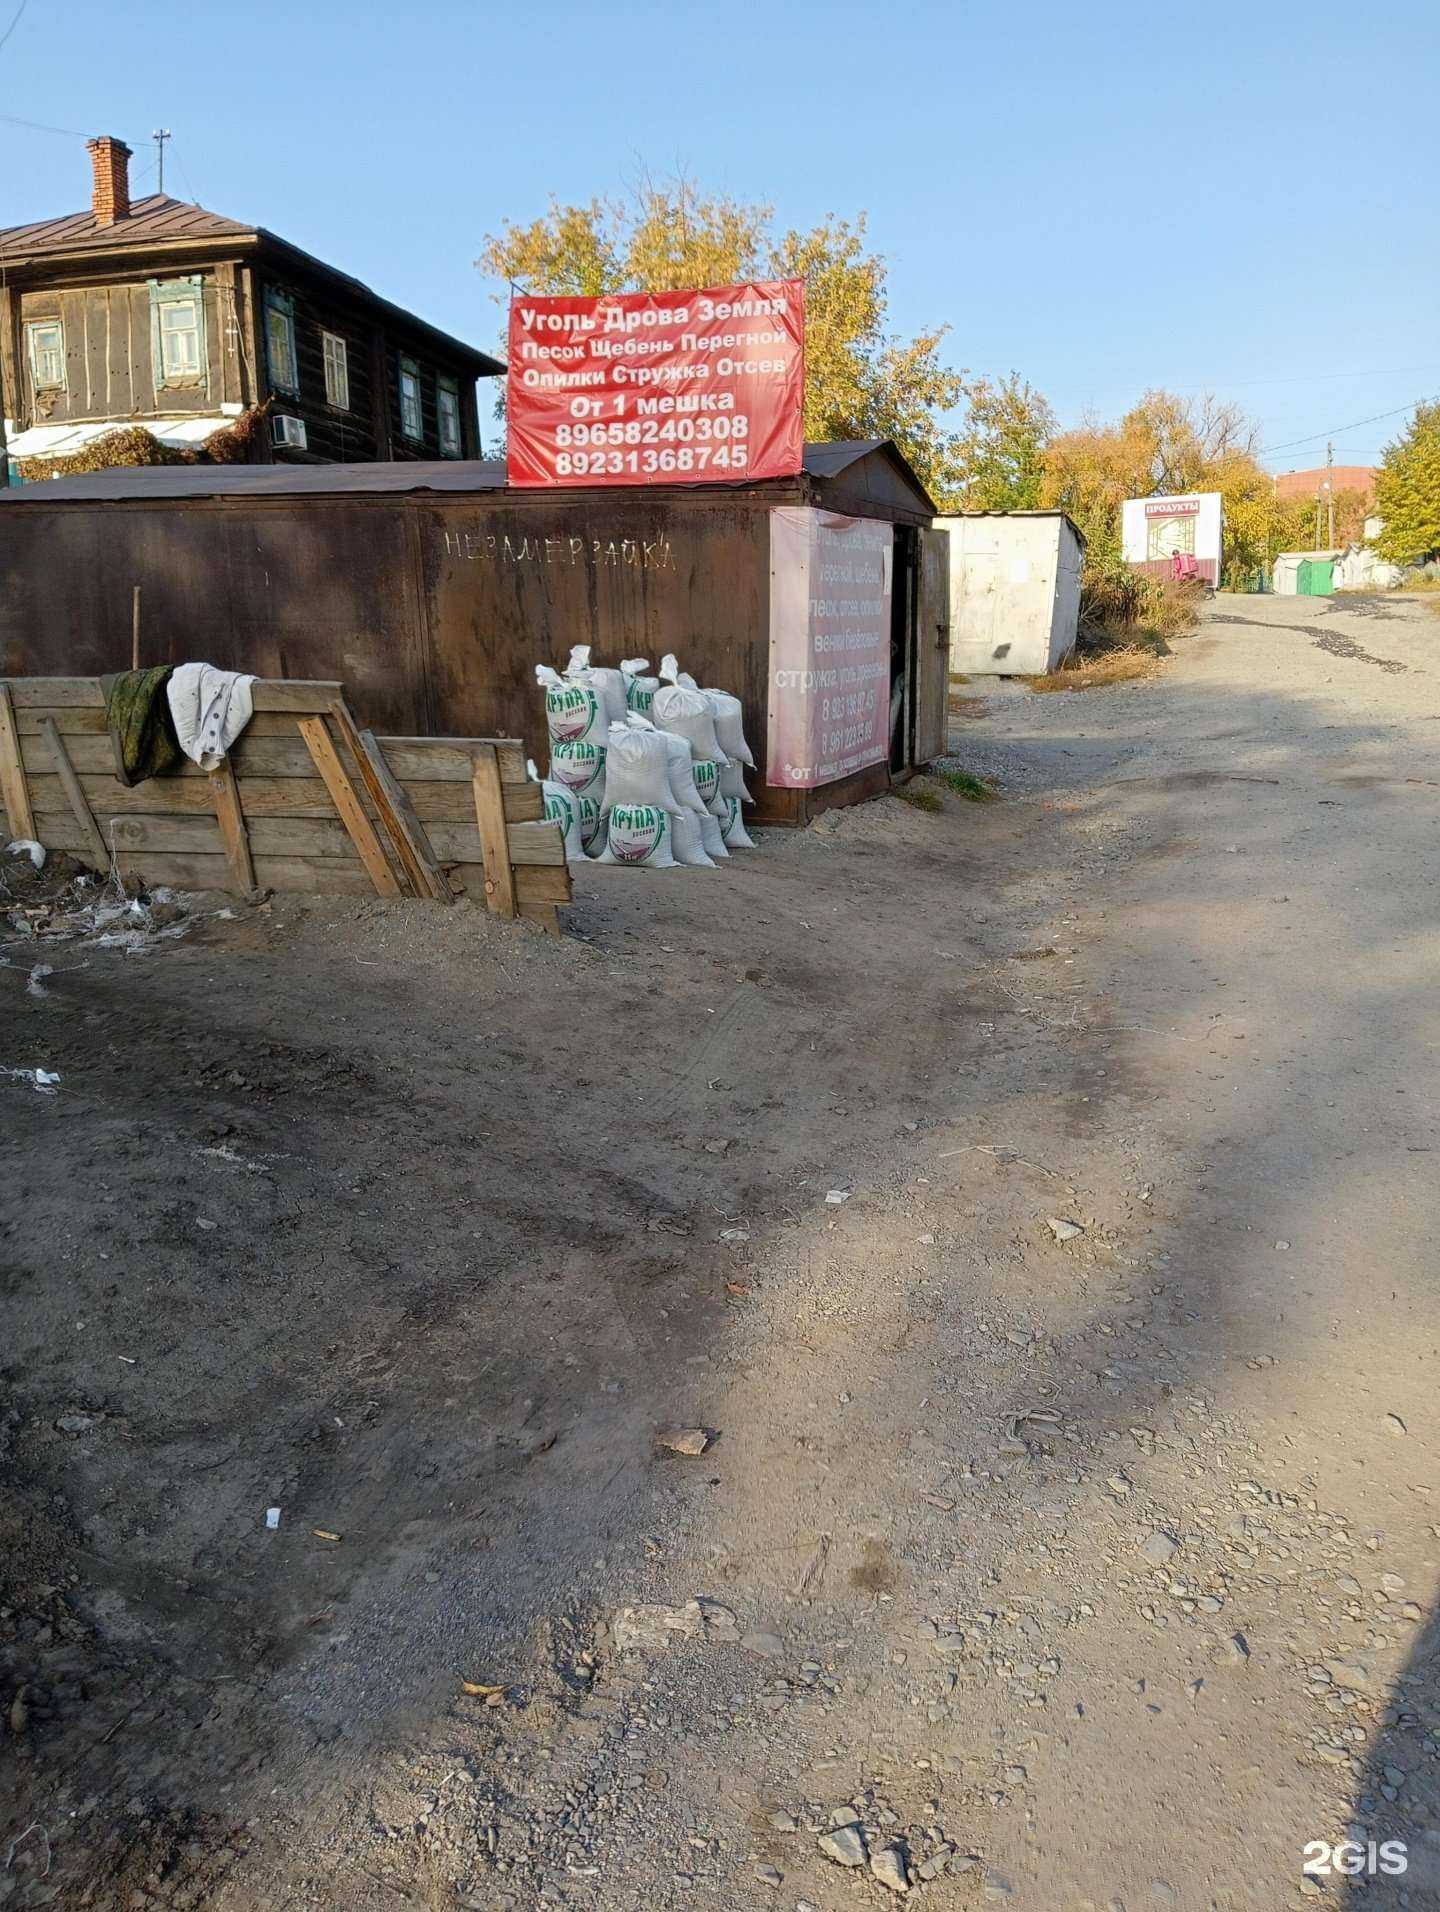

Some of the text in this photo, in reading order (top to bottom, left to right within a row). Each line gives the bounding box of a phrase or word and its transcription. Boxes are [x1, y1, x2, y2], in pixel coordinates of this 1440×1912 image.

[520, 298, 787, 332] Уголь Дрова Земля
[522, 328, 787, 360] Песок Щебень Перегной
[523, 357, 786, 387] Опилки Стружка Отсев
[570, 391, 735, 418] От 1 мешка
[555, 415, 748, 447] 89658240308
[555, 444, 748, 476] 89231368745
[1146, 502, 1198, 513] ПРОДУКТЫ
[612, 806, 655, 830] КРУПА
